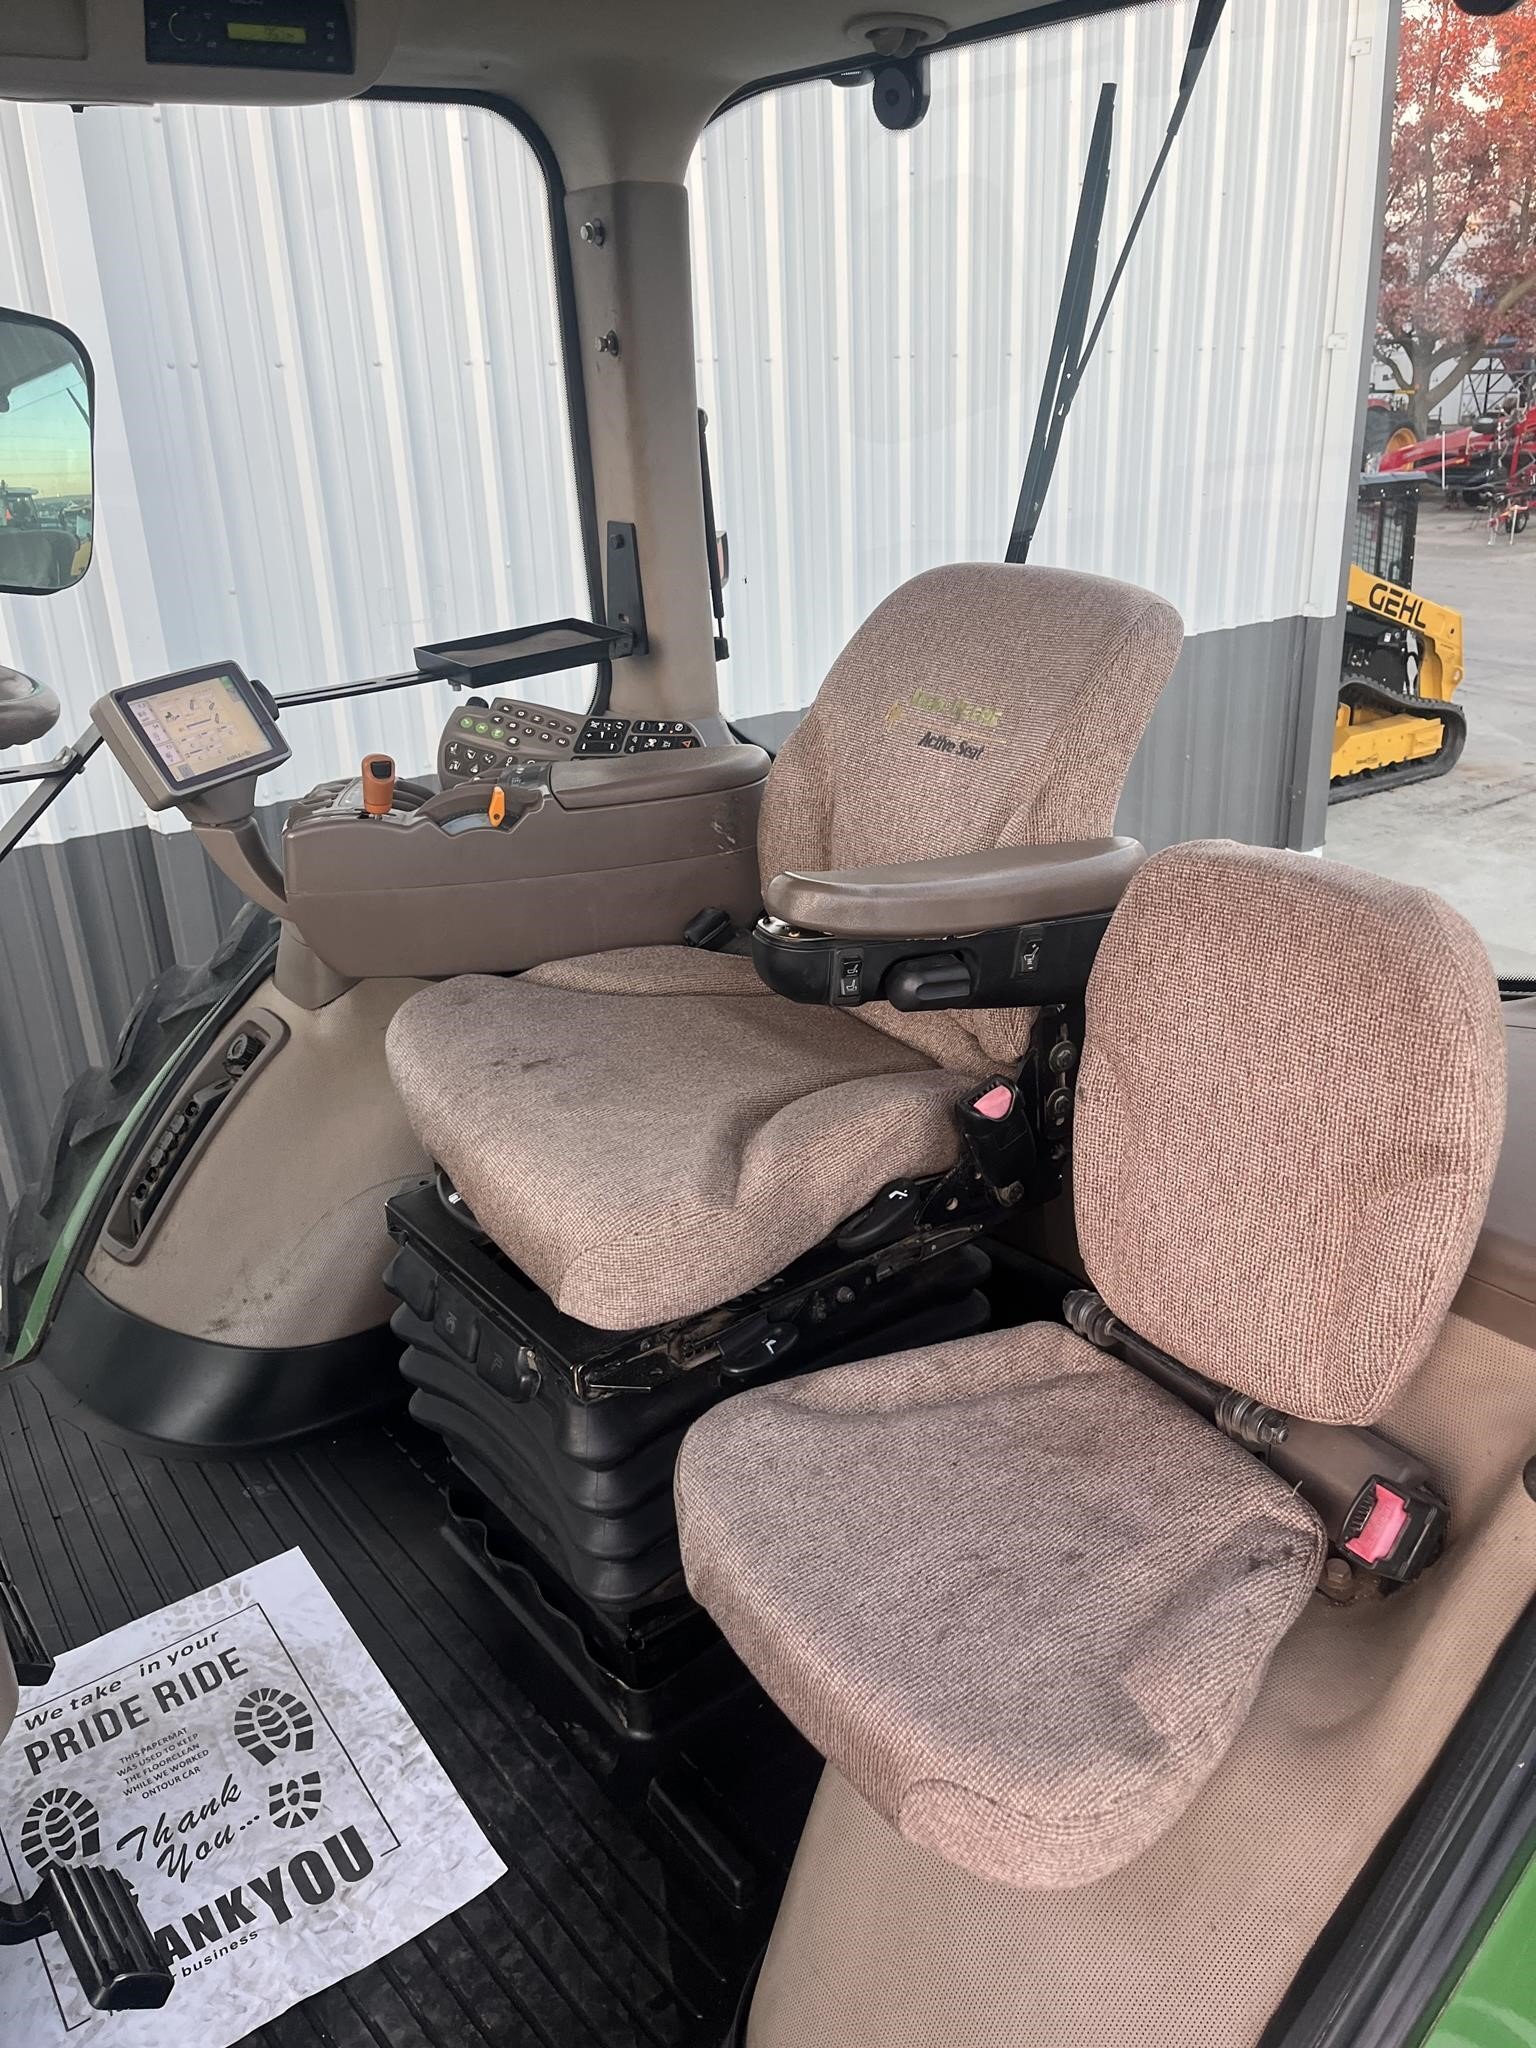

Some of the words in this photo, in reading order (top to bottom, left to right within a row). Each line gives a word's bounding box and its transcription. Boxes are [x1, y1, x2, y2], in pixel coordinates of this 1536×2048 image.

[1368, 582, 1427, 629] GEHL
[917, 730, 956, 752] Active
[956, 740, 985, 760] Seat
[24, 1707, 63, 1731] We
[70, 1680, 122, 1710] take
[139, 1659, 161, 1677] in
[167, 1631, 219, 1665] your
[23, 1694, 150, 1776] PRIDE
[151, 1646, 249, 1714] RIDE
[116, 1763, 138, 1777] WAS
[138, 1751, 162, 1766] USED
[163, 1744, 176, 1753] TO
[176, 1733, 199, 1747] KEEP
[119, 1751, 140, 1764] THIS
[140, 1727, 187, 1755] PAPERMAT
[122, 1777, 153, 1796] WHILE
[153, 1769, 169, 1781] WE
[169, 1749, 209, 1773] WORKED
[123, 1772, 141, 1785] THE
[141, 1775, 182, 1799] ONTOUR
[182, 1766, 201, 1780] CAR
[116, 1773, 242, 1862] Thank
[153, 1824, 374, 1966] ANKYOU
[181, 1930, 259, 1978] business
